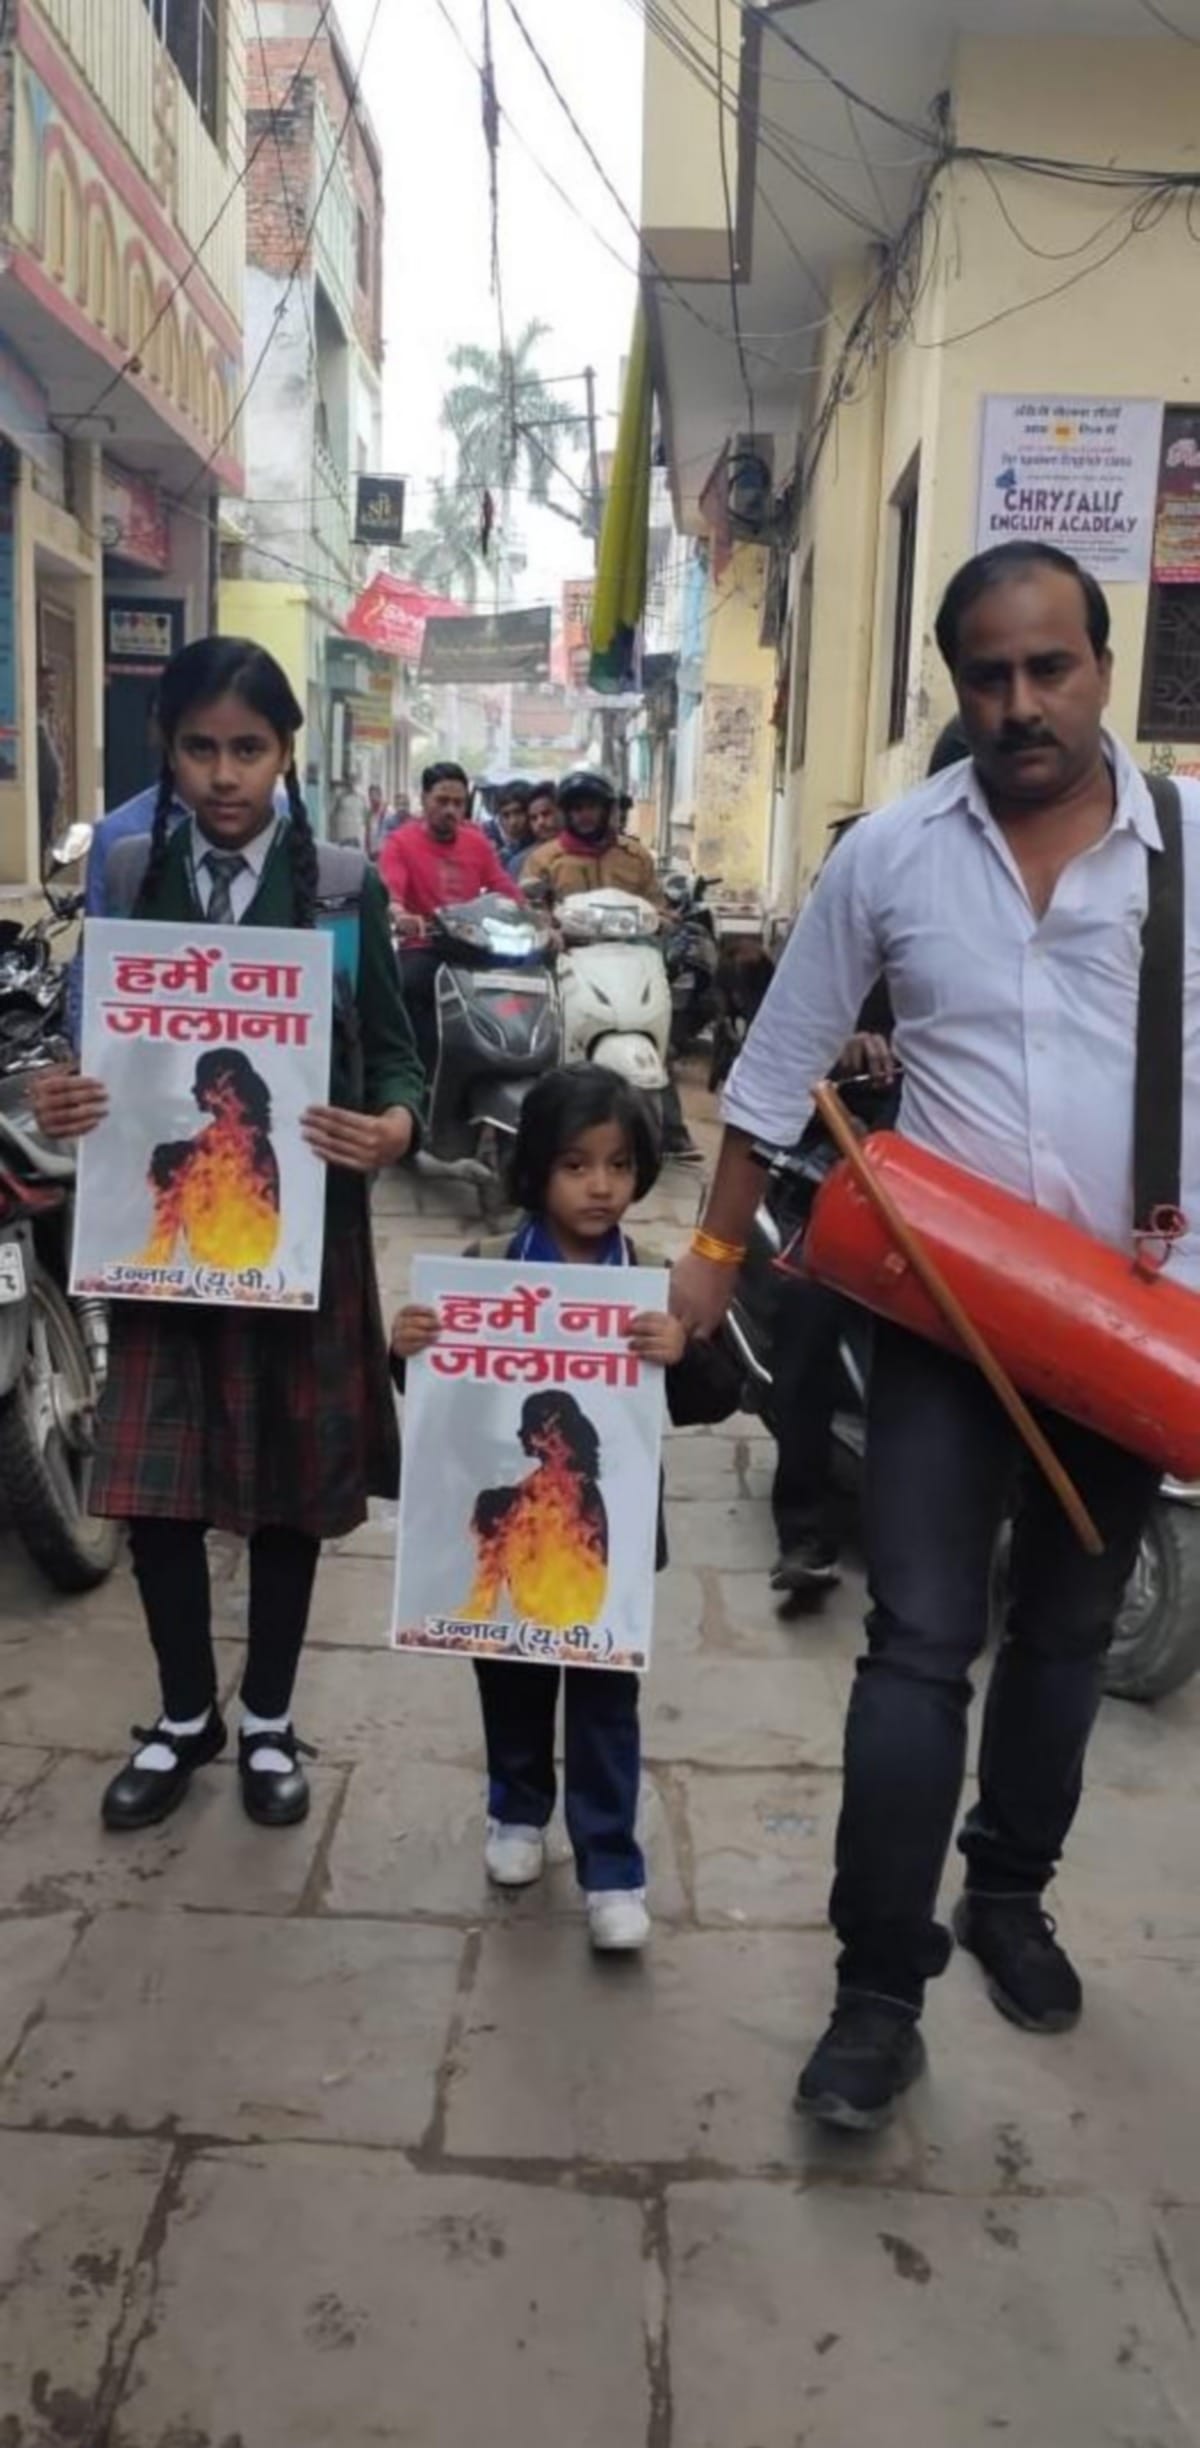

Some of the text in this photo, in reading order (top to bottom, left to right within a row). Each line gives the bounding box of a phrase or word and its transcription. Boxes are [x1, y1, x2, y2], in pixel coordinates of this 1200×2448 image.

[1004, 489, 1123, 514] CHRYSALIS
[990, 514, 1138, 533] ENGLISH ACADEMY
[112, 946, 302, 999] हमें ना
[101, 1001, 313, 1046] जलाना
[106, 1265, 186, 1285] उन्नाव
[439, 1285, 637, 1338] हमें ना
[430, 1342, 641, 1388] जलाना
[429, 1617, 510, 1641] उन्नाव
